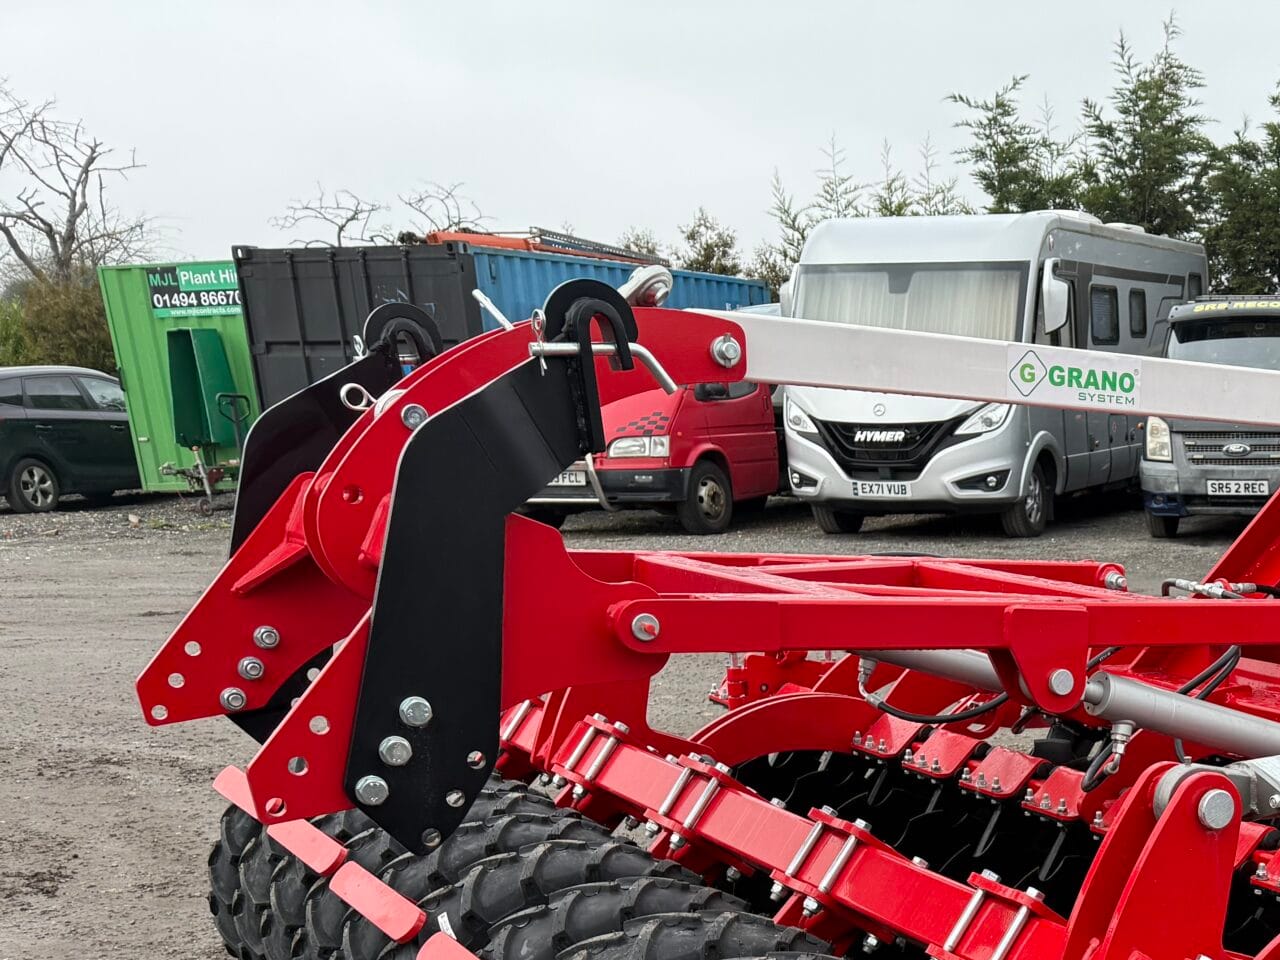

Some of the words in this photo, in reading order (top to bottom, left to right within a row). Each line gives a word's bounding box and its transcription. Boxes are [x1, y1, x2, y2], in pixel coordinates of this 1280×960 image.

[149, 273, 178, 287] MJL
[181, 270, 217, 286] Plant
[153, 292, 198, 308] 01494
[1048, 365, 1135, 394] GRANO
[1078, 392, 1135, 405] SYSTEM
[854, 430, 905, 442] HYMER
[562, 472, 581, 484] FCL
[861, 483, 884, 494] EX71
[886, 483, 907, 495] VUB
[1244, 482, 1265, 493] REC
